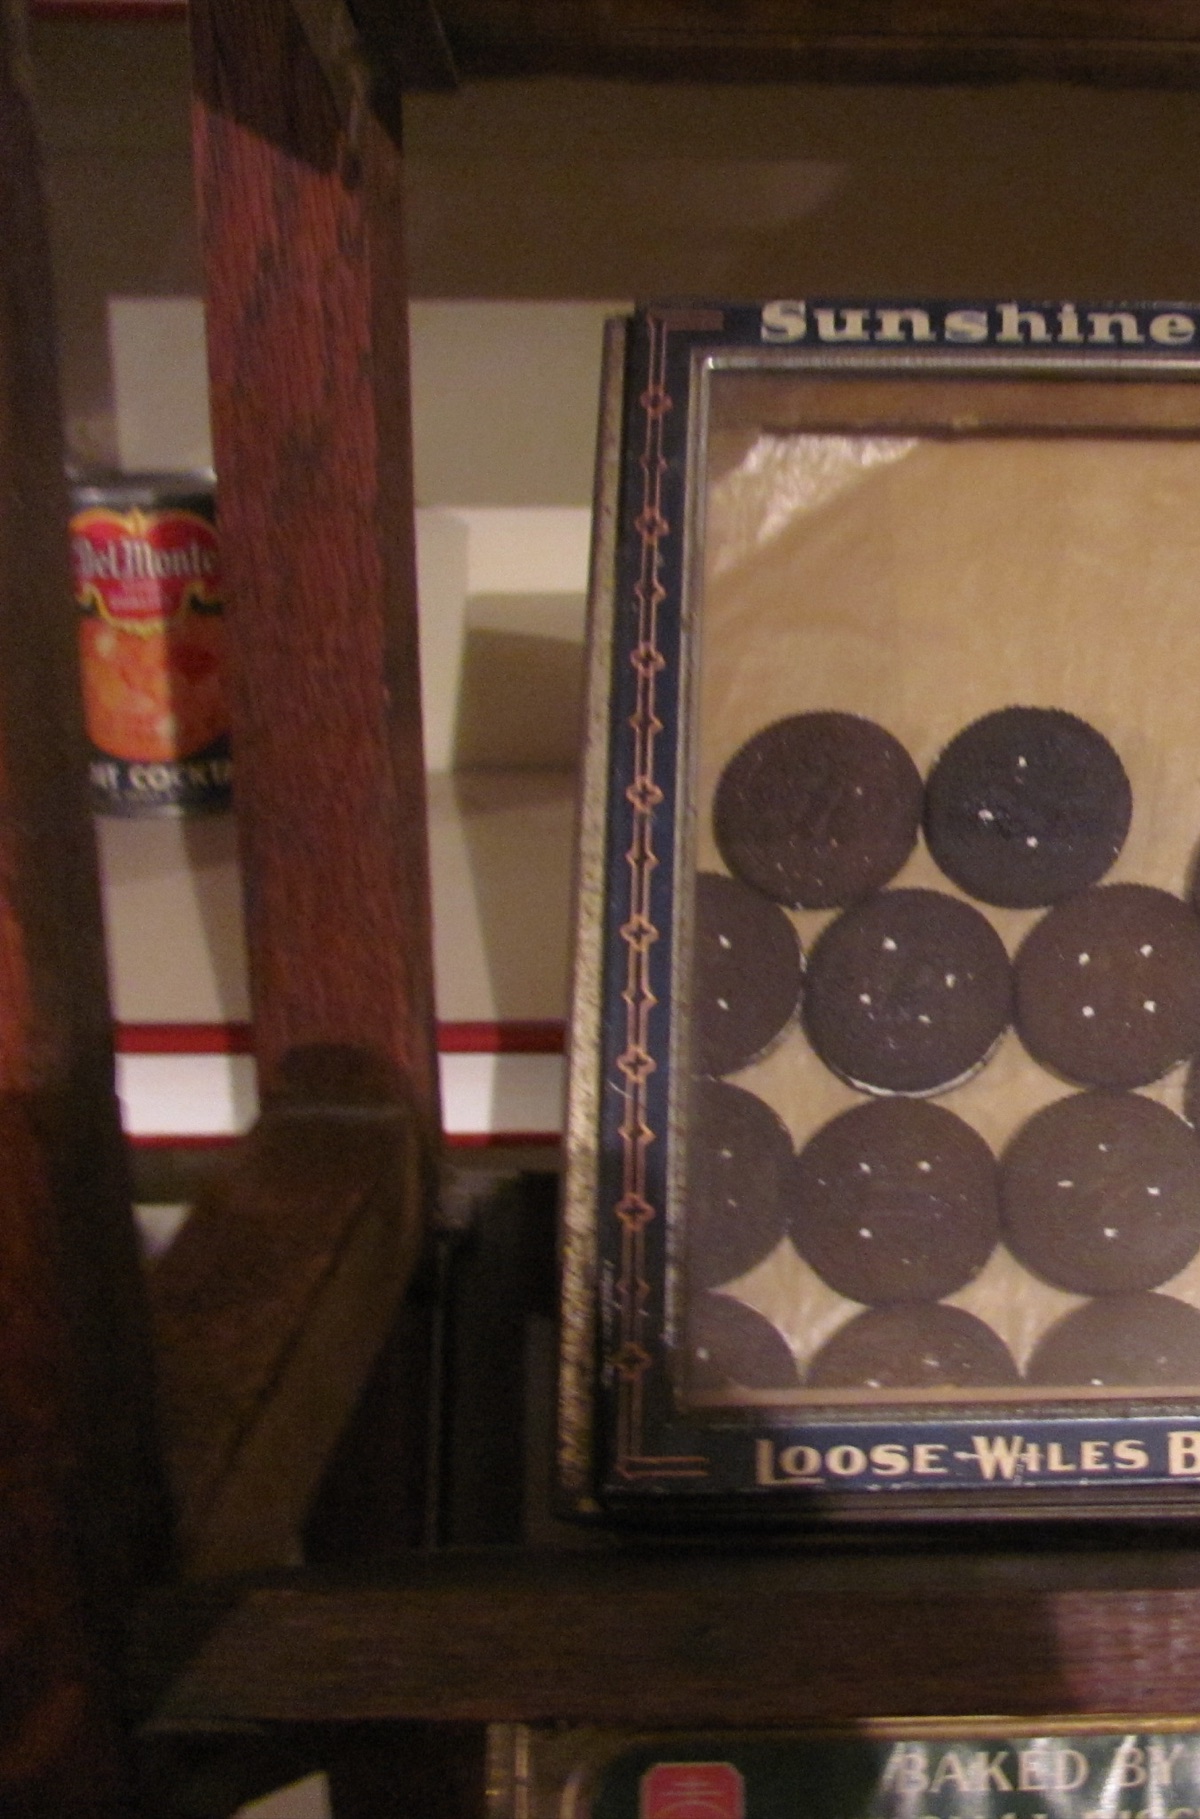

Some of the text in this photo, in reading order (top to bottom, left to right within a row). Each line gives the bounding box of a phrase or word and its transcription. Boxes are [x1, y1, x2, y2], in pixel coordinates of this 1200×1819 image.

[760, 299, 1196, 344] Sunshine
[894, 1750, 1090, 1794] BAKED
[1112, 1744, 1188, 1788] BY
